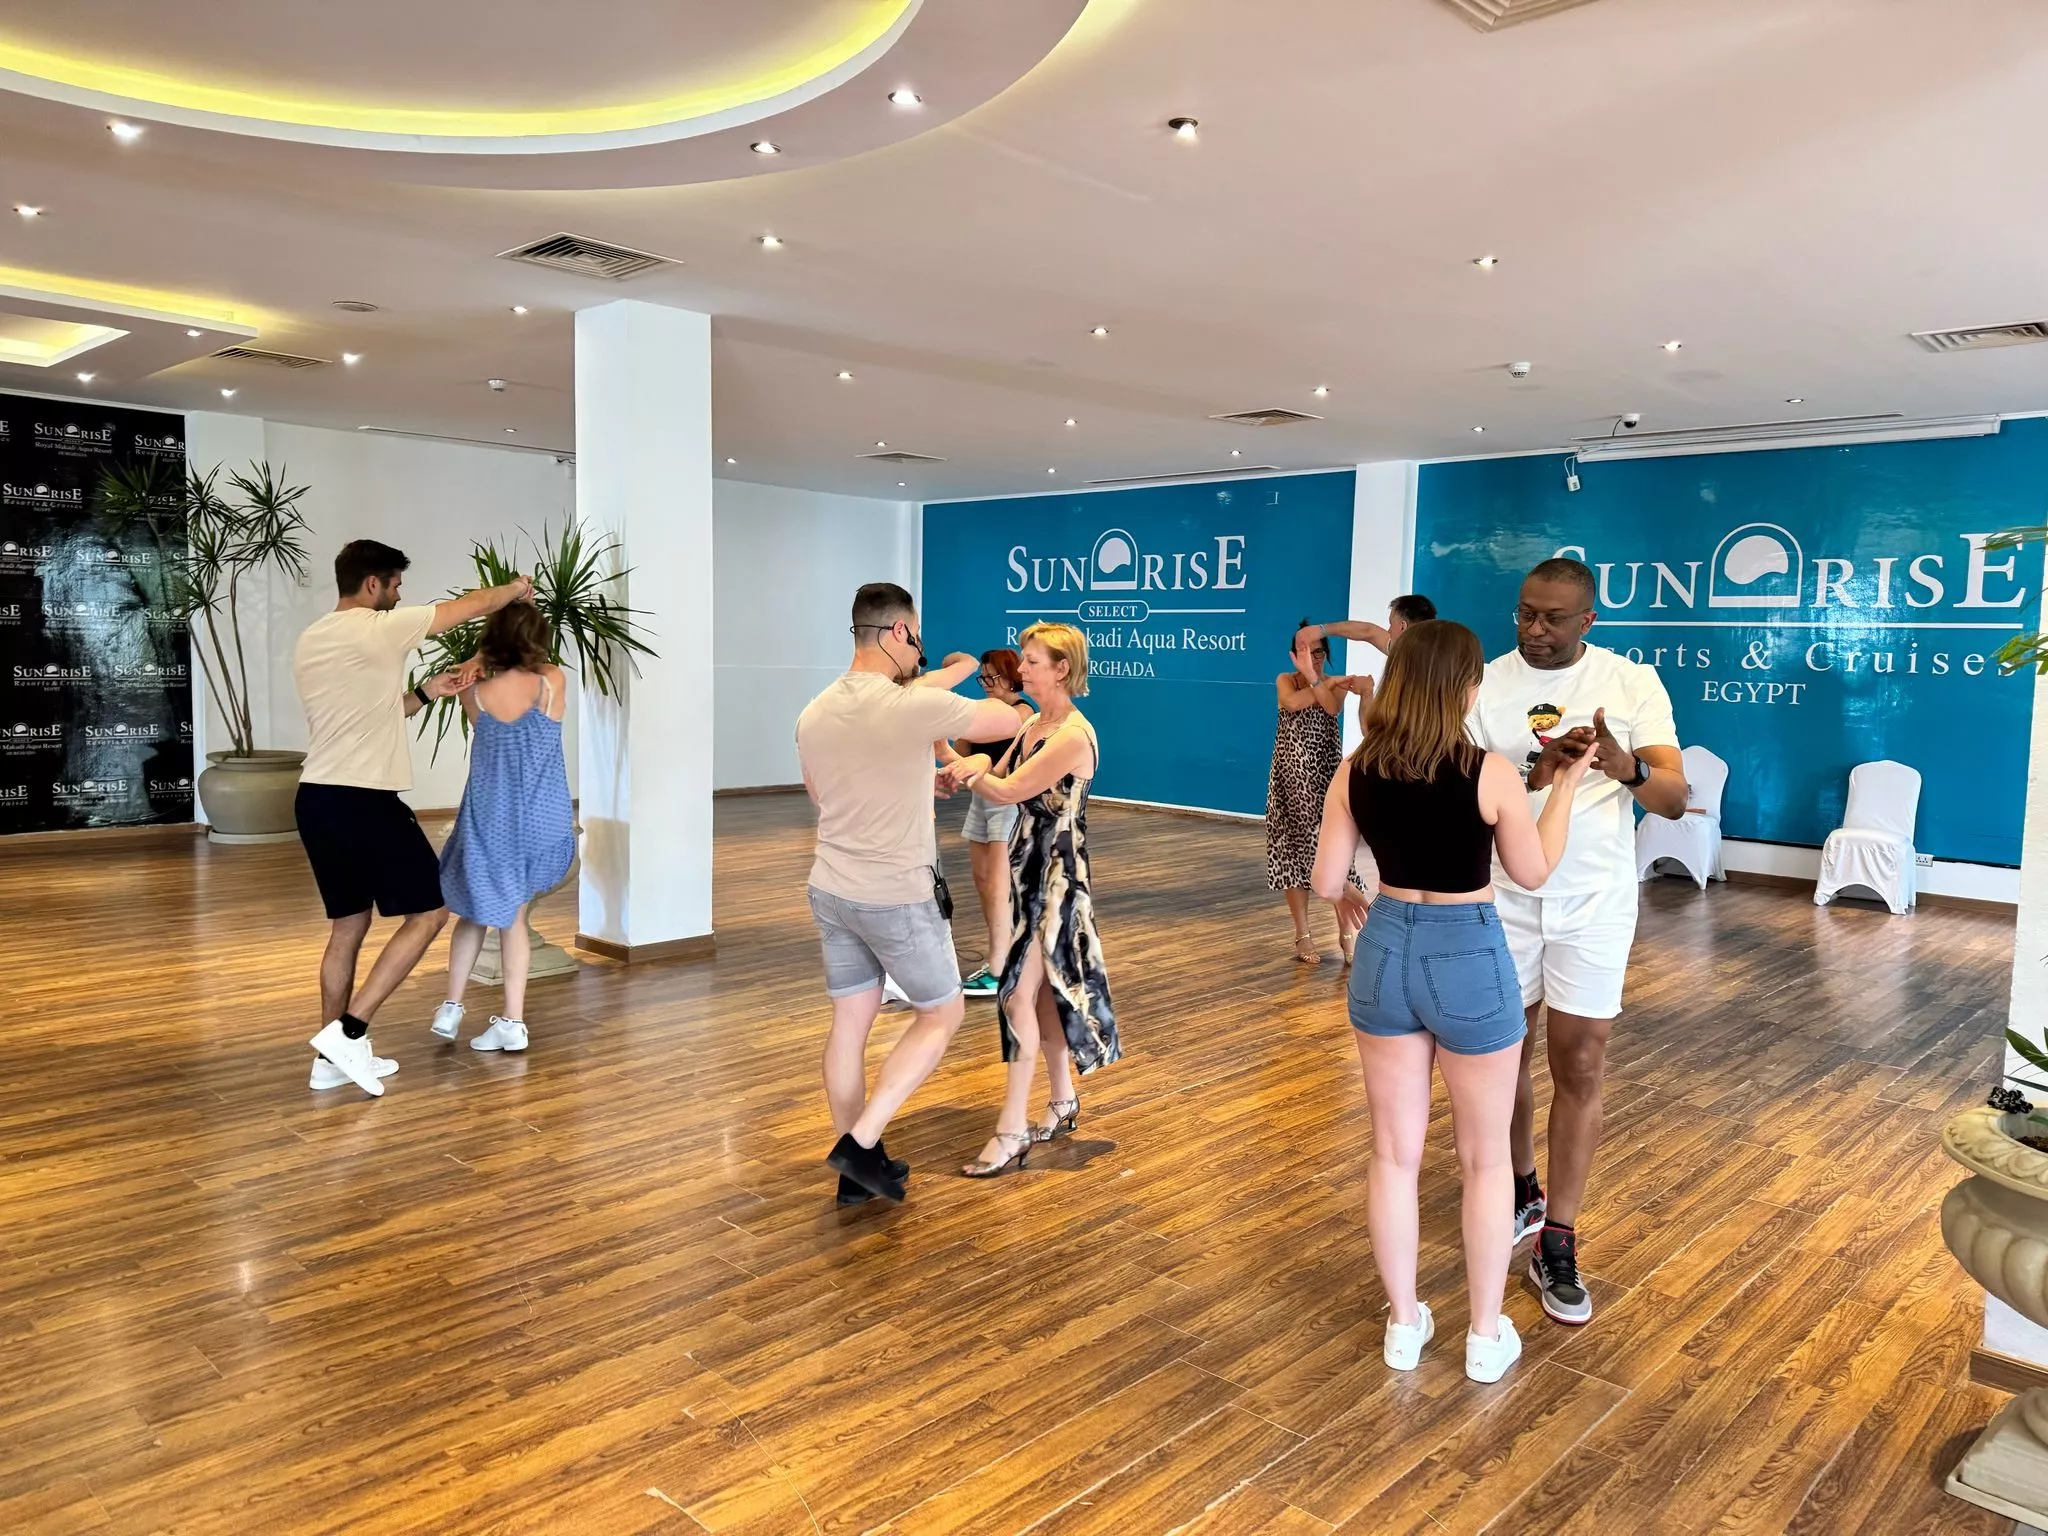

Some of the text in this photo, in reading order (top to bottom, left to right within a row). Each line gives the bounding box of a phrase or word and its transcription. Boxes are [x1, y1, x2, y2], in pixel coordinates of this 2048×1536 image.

[1006, 535, 1247, 593] SUNRISE
[1551, 533, 2026, 609] UNRISE
[1088, 605, 1138, 618] SELECT
[1086, 627, 1247, 655] kadi Aqua Resort
[1605, 643, 1712, 669] orts
[1741, 640, 1772, 670] &
[1088, 660, 1155, 677] RGHADA
[1701, 680, 1806, 705] EGYPT
